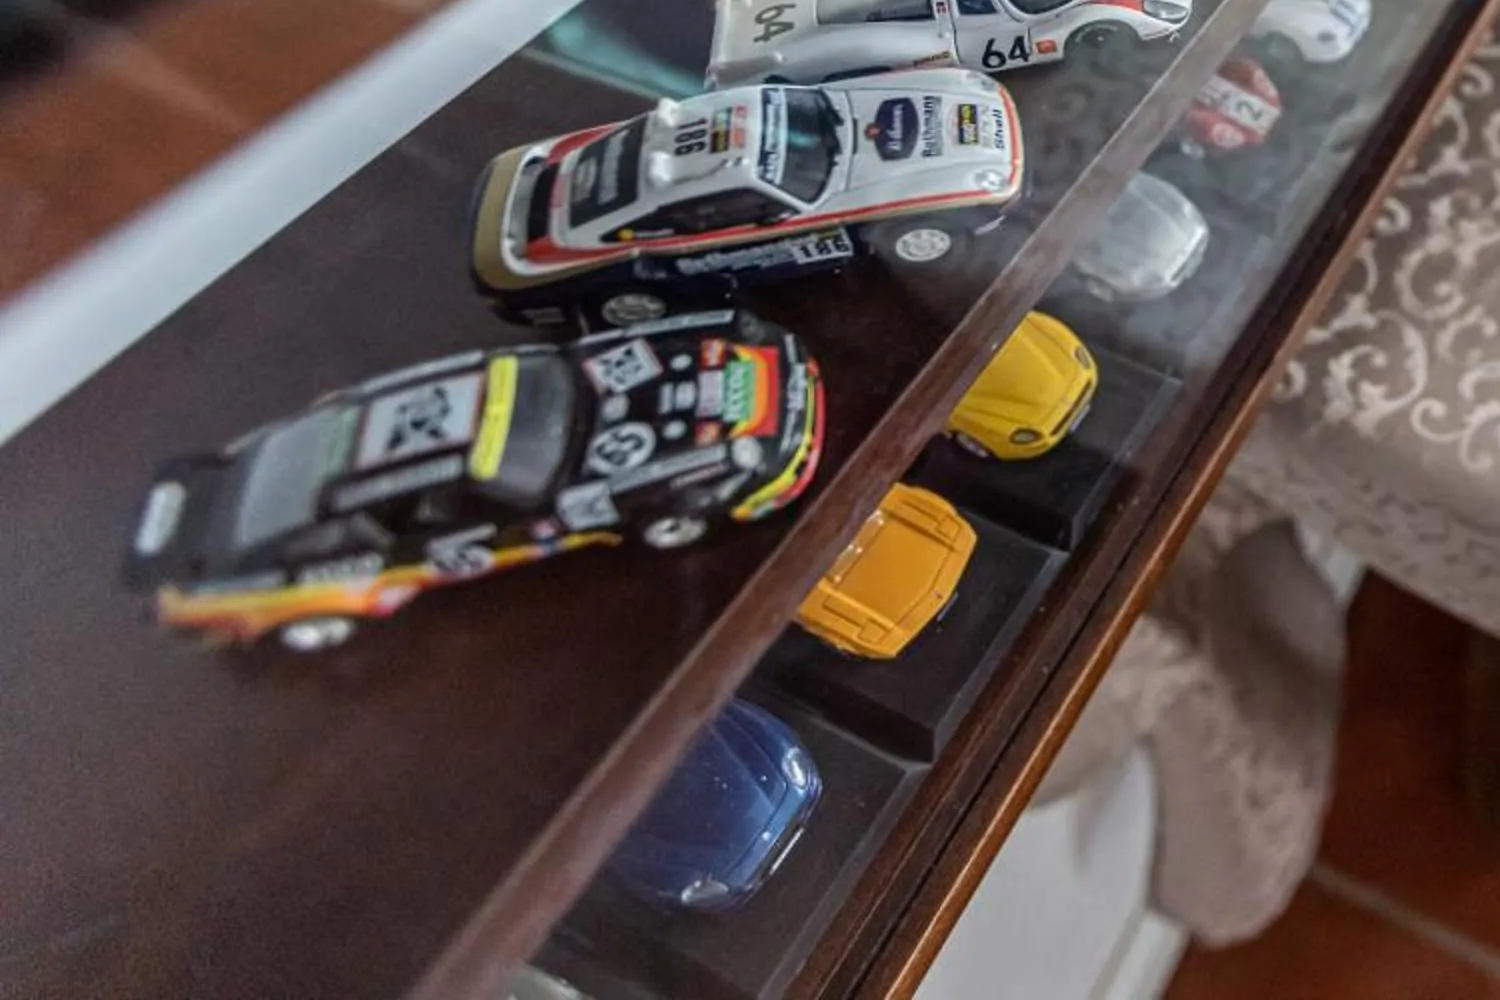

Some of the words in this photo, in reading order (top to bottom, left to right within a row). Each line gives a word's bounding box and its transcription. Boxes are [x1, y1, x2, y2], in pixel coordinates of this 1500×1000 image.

[754, 3, 796, 42] 64
[982, 35, 1031, 69] 64
[674, 117, 708, 156] 186
[798, 236, 850, 261] 186
